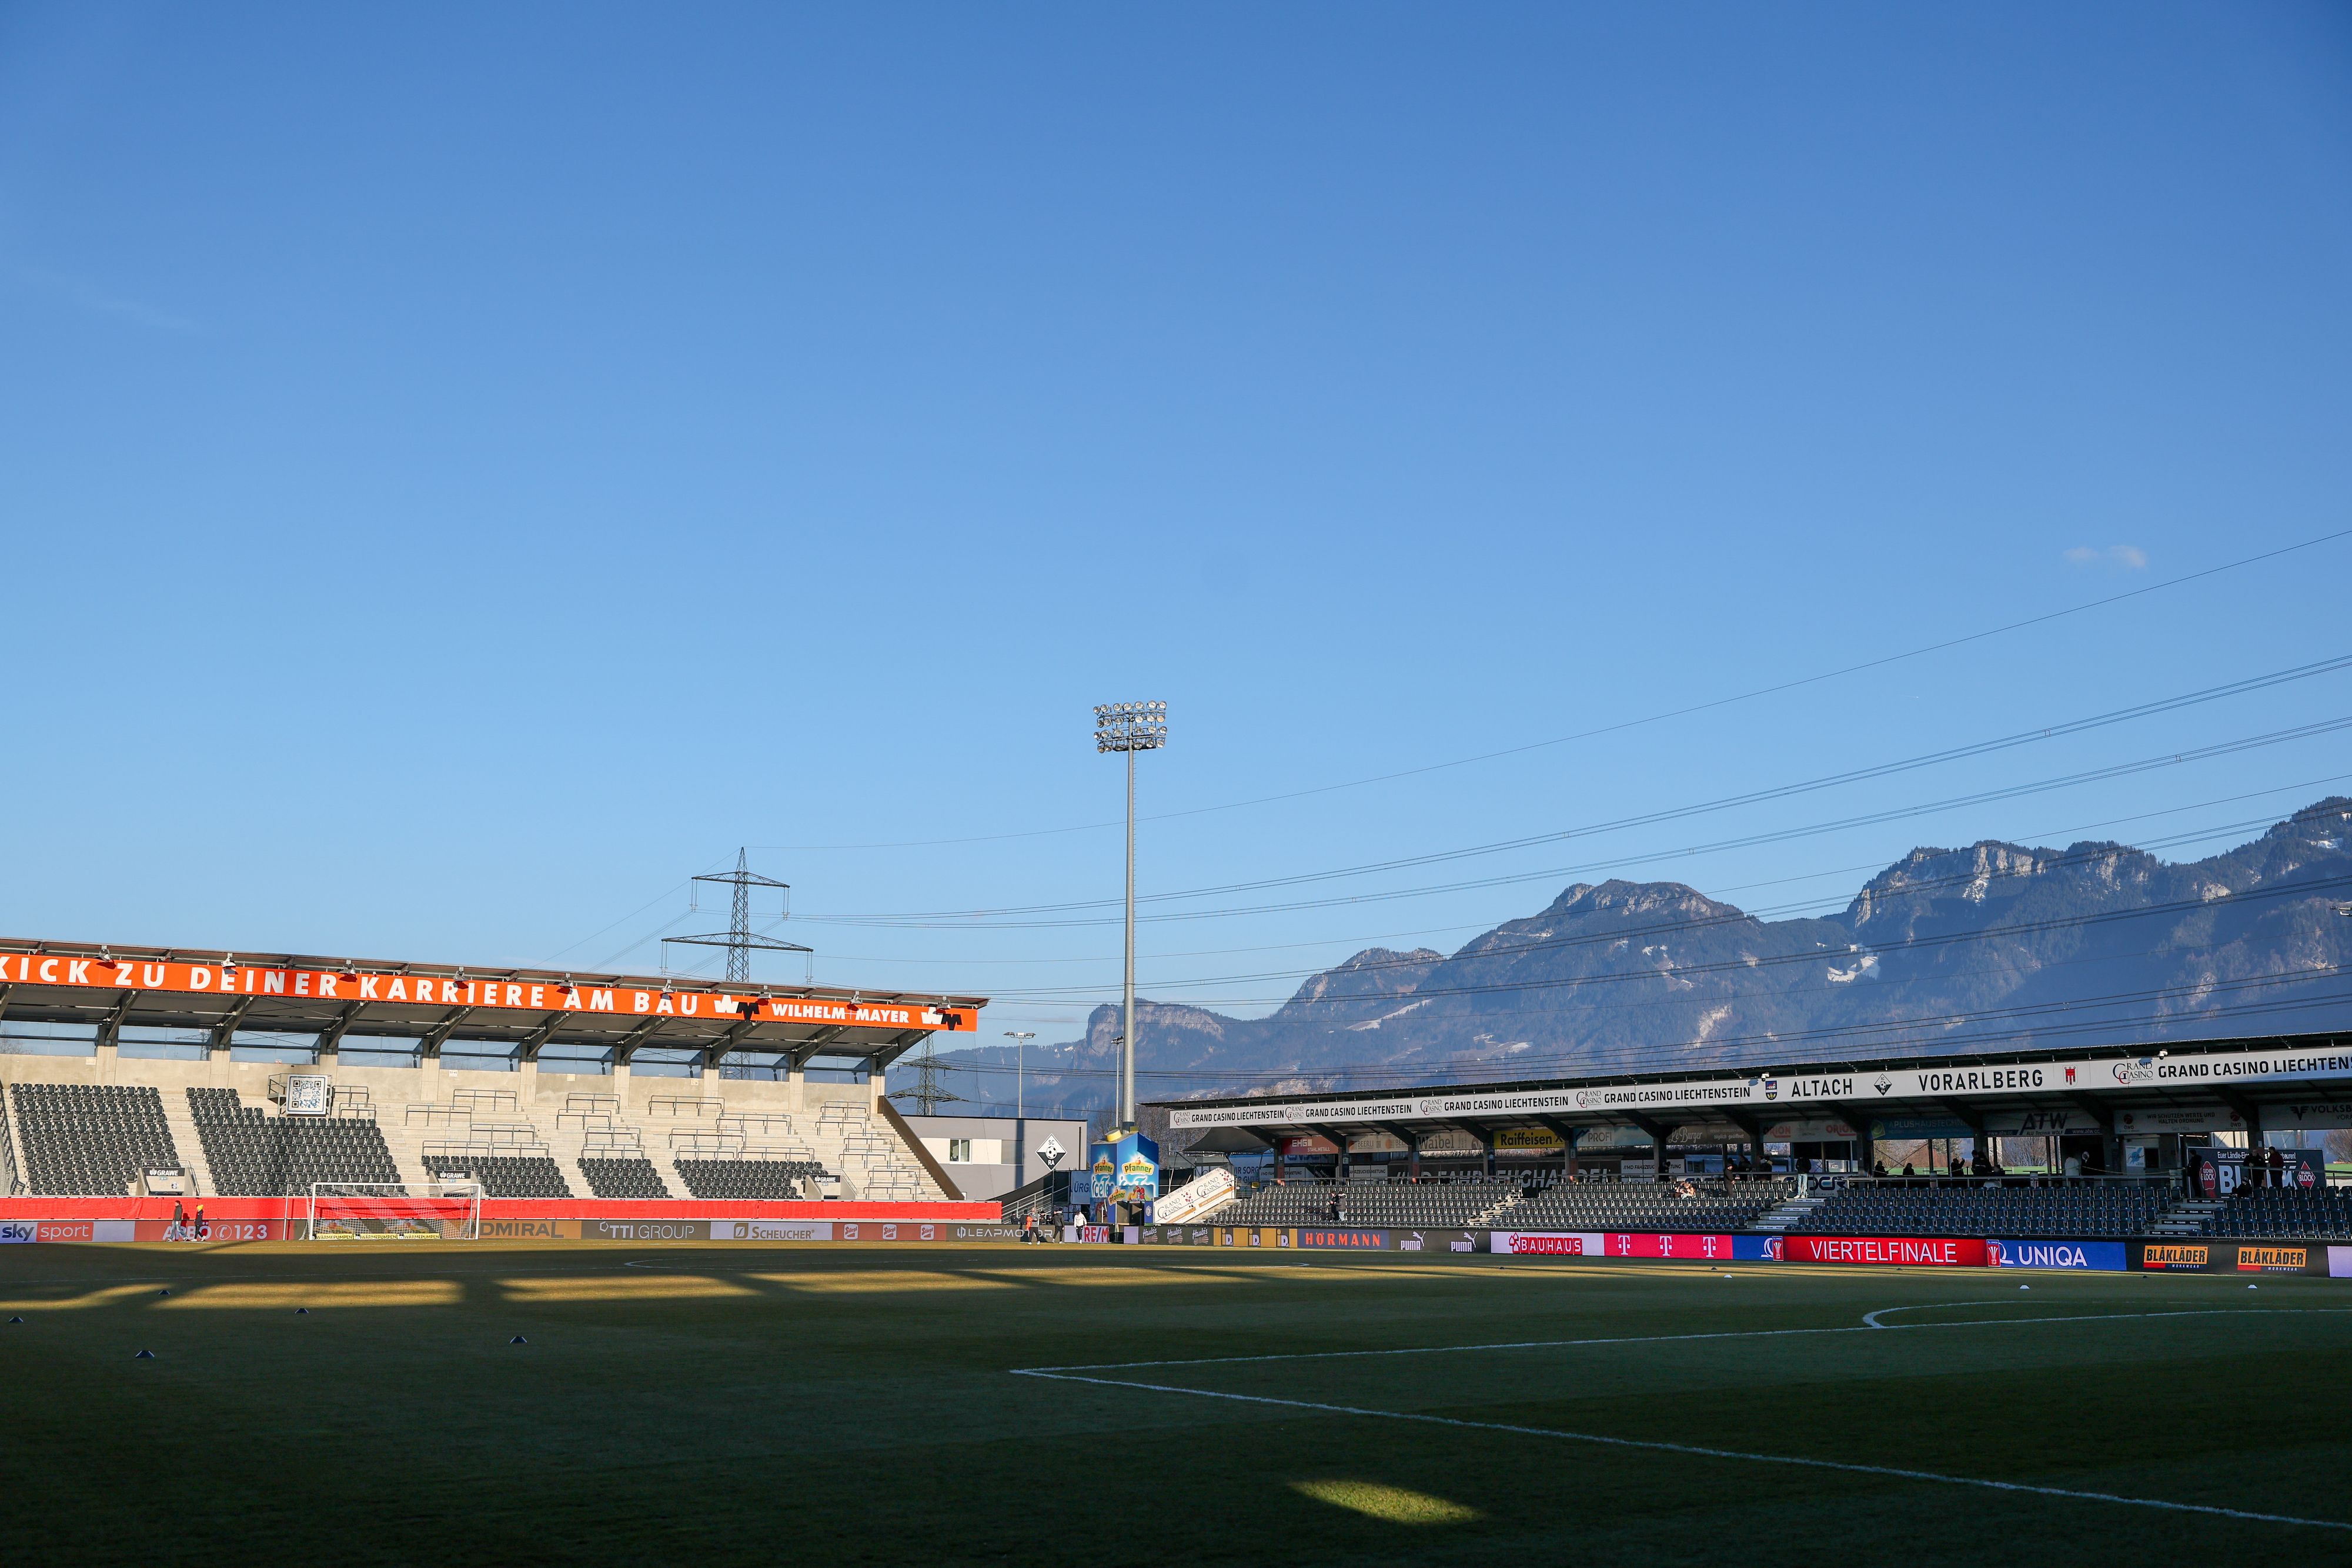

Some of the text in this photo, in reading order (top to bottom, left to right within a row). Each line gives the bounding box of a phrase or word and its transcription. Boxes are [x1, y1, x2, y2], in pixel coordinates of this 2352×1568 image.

[115, 962, 165, 988] ZU
[190, 966, 338, 997] DEINER
[360, 976, 543, 1008] KARRIERE
[564, 985, 614, 1011] AM
[634, 991, 698, 1016] BAU
[2159, 1064, 2209, 1078] GRAND
[2214, 1060, 2269, 1076] CASINO
[1918, 1069, 2043, 1091] VORARLBERG
[1791, 1078, 1853, 1097] ALTACH
[1604, 1086, 1750, 1104] GRAND CASINO LIECHTENSTEIN
[1305, 1104, 1412, 1118] GRAND CASINO LIECHTENSTEIN
[1444, 1096, 1569, 1112] GRAND CASINO LIECHTENSTEIN
[1191, 1109, 1284, 1122] GRAND CASINO LIECHTENSTEIN
[1292, 1139, 1308, 1147] EHG
[1417, 1135, 1455, 1149] Waibel
[1501, 1132, 1552, 1146] Raiffeisen
[1588, 1132, 1612, 1142] PROFI
[1095, 1164, 1112, 1173] Pfanner
[1124, 1164, 1152, 1174] Pfanner
[1108, 1191, 1125, 1203] Pfanner
[2, 1223, 89, 1242] sky sport
[235, 1224, 268, 1240] 123
[609, 1225, 694, 1239] TTI GROUP
[1305, 1232, 1381, 1246] HÖRMANN
[1400, 1240, 1421, 1251] PUMA
[1451, 1241, 1472, 1252] PUMA
[1522, 1238, 1582, 1253] BAUHAUS
[1810, 1240, 1957, 1263] VIERTELFINALE
[2019, 1246, 2087, 1266] UNIQA
[2146, 1246, 2205, 1263] BLÅKLÄDER
[2240, 1248, 2304, 1265] BLÅKLÄDER
